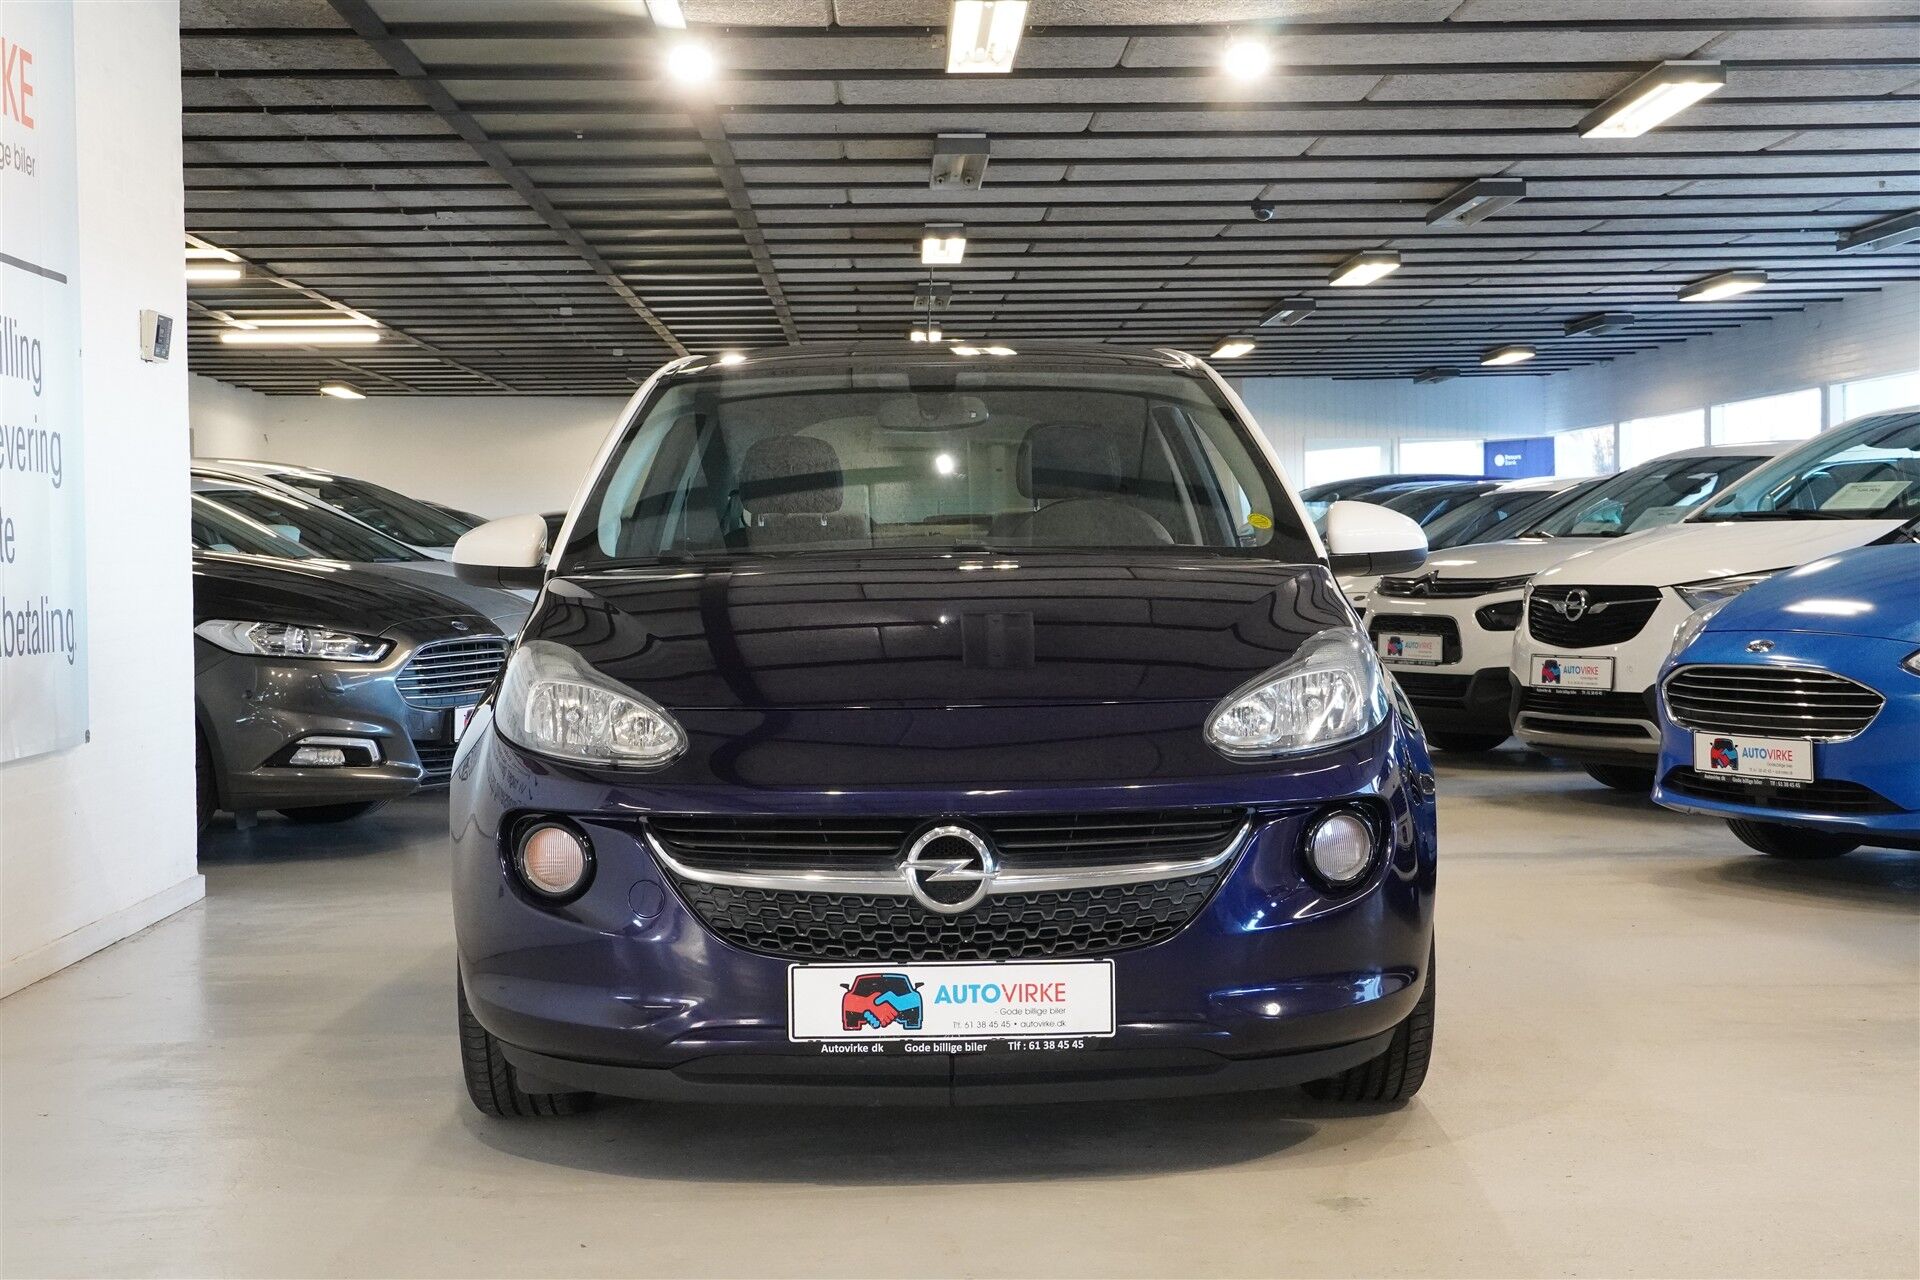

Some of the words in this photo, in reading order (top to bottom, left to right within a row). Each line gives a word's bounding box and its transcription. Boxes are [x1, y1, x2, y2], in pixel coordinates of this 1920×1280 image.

[13, 143, 35, 178] biler
[1563, 665, 1599, 676] AUTOVIRKE
[1742, 747, 1793, 762] AUTOVIRKE
[934, 982, 1067, 1005] AUTOVIRKE
[1000, 1007, 1023, 1016] Gode
[1024, 1006, 1047, 1018] billige
[1049, 1006, 1066, 1015] biler
[964, 1020, 974, 1029] 61
[976, 1020, 987, 1029] 38
[988, 1020, 999, 1028] 45
[1000, 1020, 1011, 1028] 45
[821, 1043, 869, 1053] Autovirke
[871, 1043, 884, 1053] dk
[904, 1043, 931, 1053] Gode
[933, 1042, 963, 1054] billige
[965, 1042, 988, 1052] biler
[1008, 1041, 1022, 1051] Tlf
[1028, 1041, 1041, 1050] 61
[1043, 1041, 1055, 1050] 38
[1057, 1040, 1070, 1050] 45
[1072, 1039, 1085, 1050] 45
